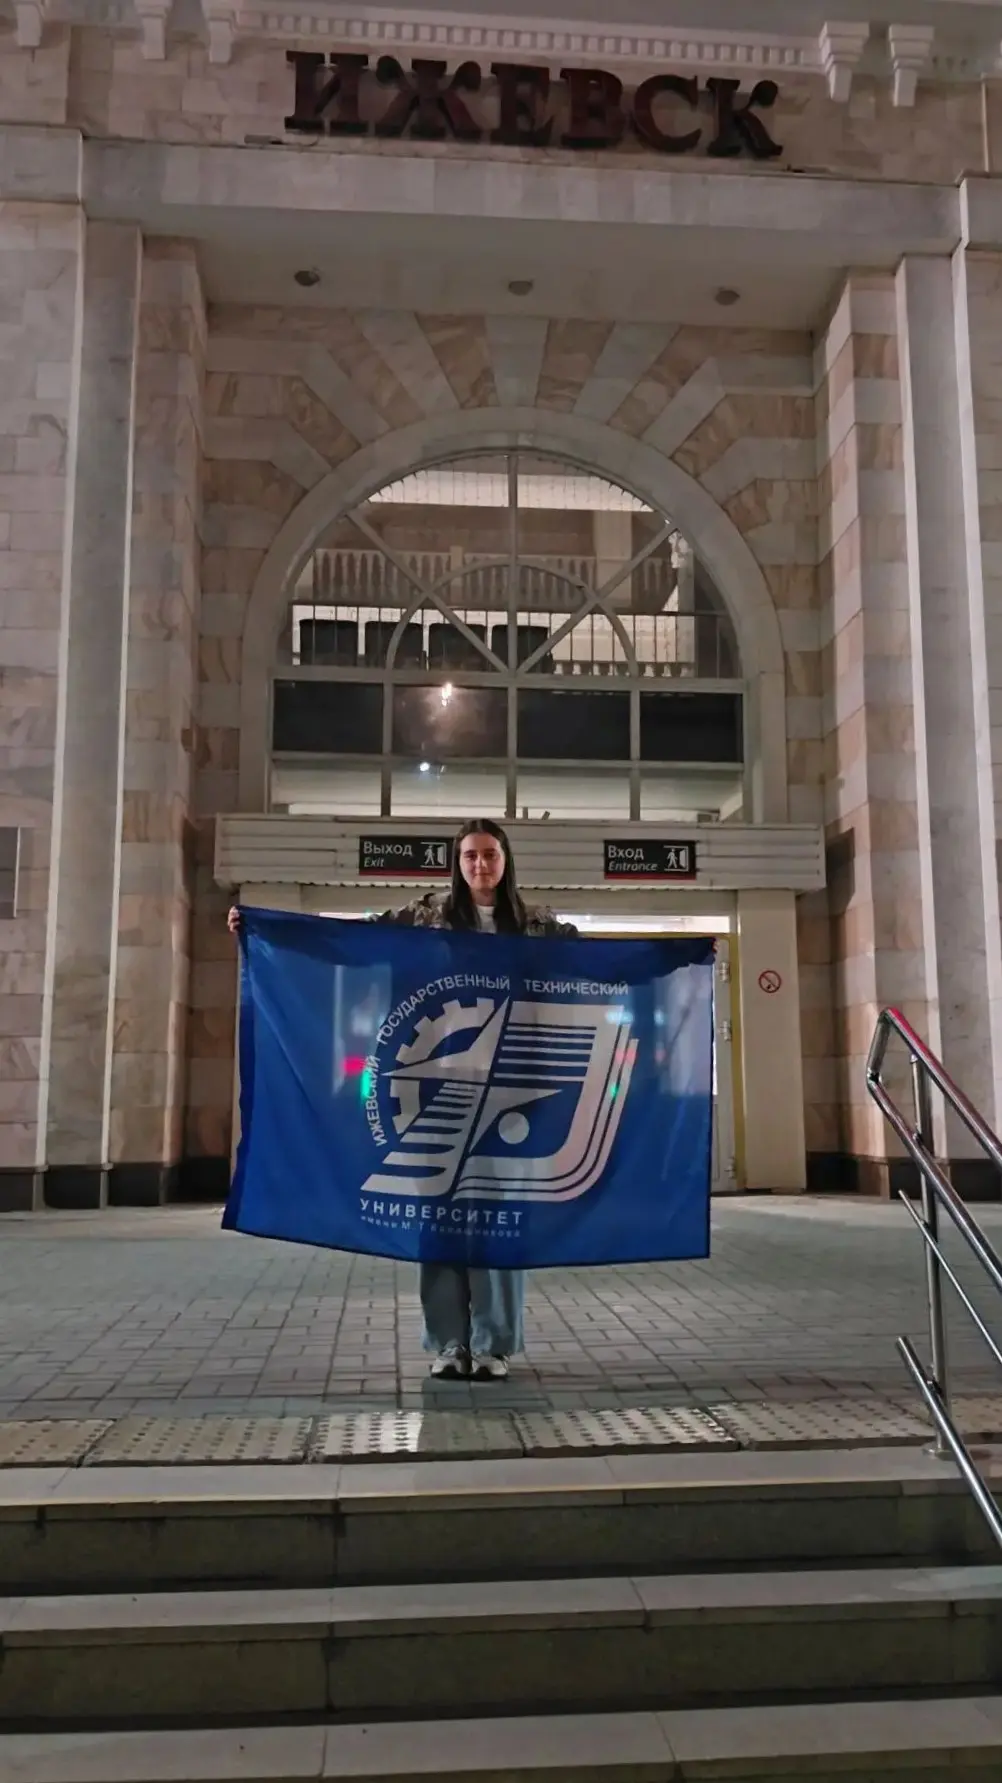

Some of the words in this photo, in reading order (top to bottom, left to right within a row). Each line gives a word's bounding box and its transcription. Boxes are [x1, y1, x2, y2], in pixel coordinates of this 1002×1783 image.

[285, 50, 783, 158] ИЖЕВСК
[363, 840, 413, 857] Выход
[607, 845, 645, 861] Вход
[363, 856, 385, 868] Exit
[607, 860, 658, 872] Entrance
[524, 979, 629, 995] ТЕХНИЧЕСКИЙ
[376, 974, 511, 1045] ГОСУДАРСТВЕННЫЙ
[365, 1055, 388, 1147] ИЖЕВСКИЙ
[360, 1198, 523, 1225] УНИВЕРСИТЕТ
